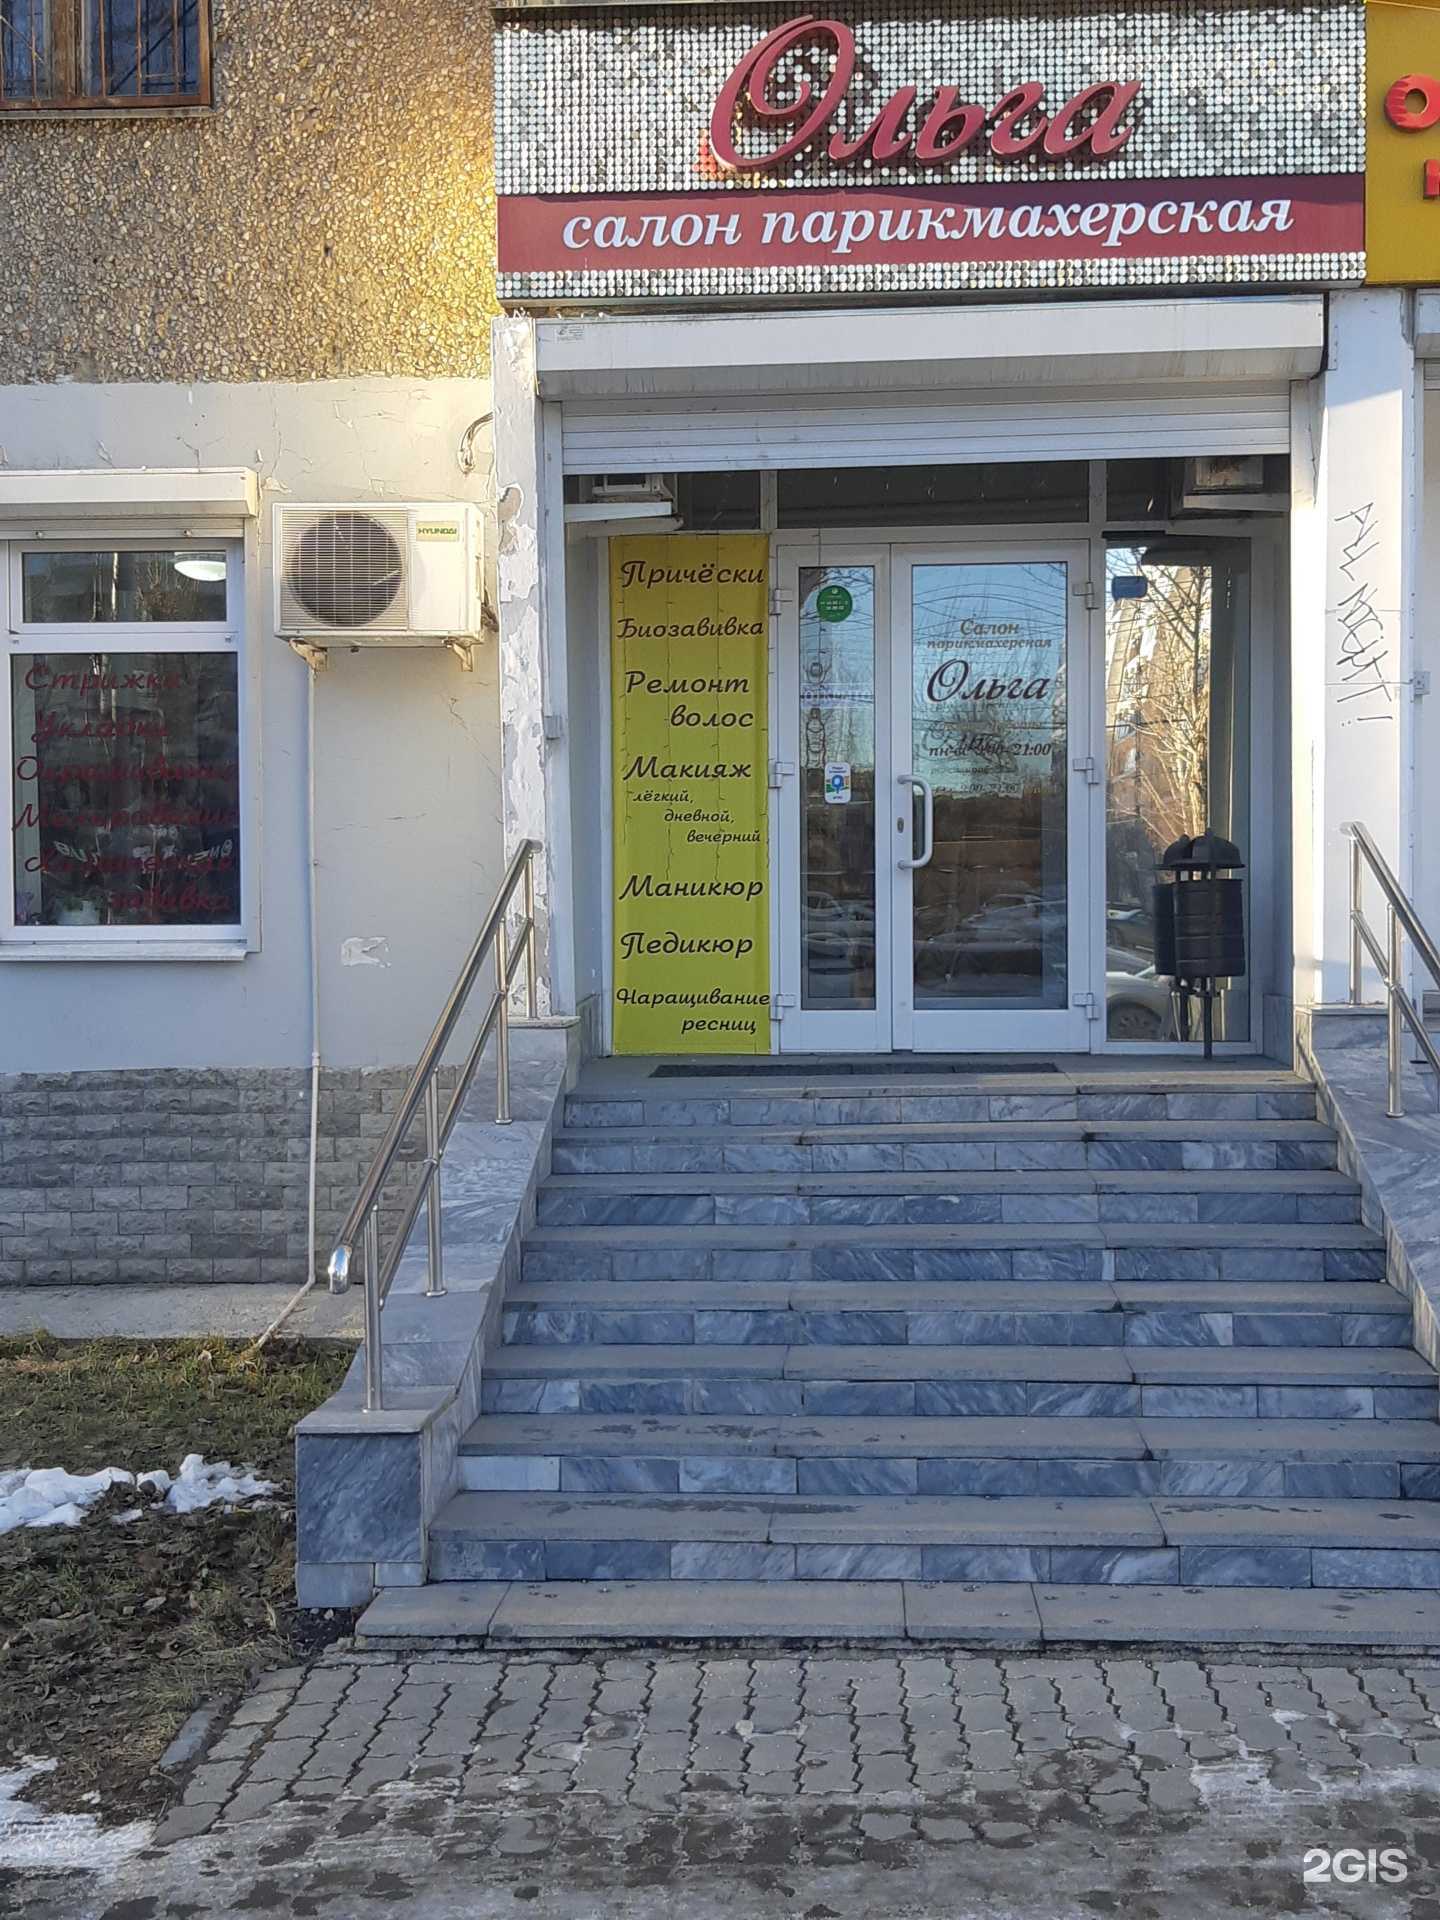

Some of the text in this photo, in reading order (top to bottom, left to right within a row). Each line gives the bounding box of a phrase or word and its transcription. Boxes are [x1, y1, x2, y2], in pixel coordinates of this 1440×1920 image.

[709, 14, 1143, 172] Ольга
[562, 196, 1294, 255] салон парикмахерская
[418, 527, 457, 535] HYUNDAI
[620, 560, 765, 588] Причёски
[617, 617, 764, 638] Биозавивка
[960, 618, 1020, 636] Салон
[625, 671, 749, 693] Ремонт
[927, 658, 1050, 701] Ольга
[671, 705, 753, 727] волос
[623, 756, 751, 780] Макияж
[633, 789, 694, 804] лёгкий,
[664, 809, 735, 823] дневной,
[687, 829, 760, 845] вечерний
[619, 874, 763, 901] Маникюр
[620, 931, 753, 959] Педикюр
[616, 988, 770, 1009] Наращивание
[681, 1017, 756, 1034] ресниц
